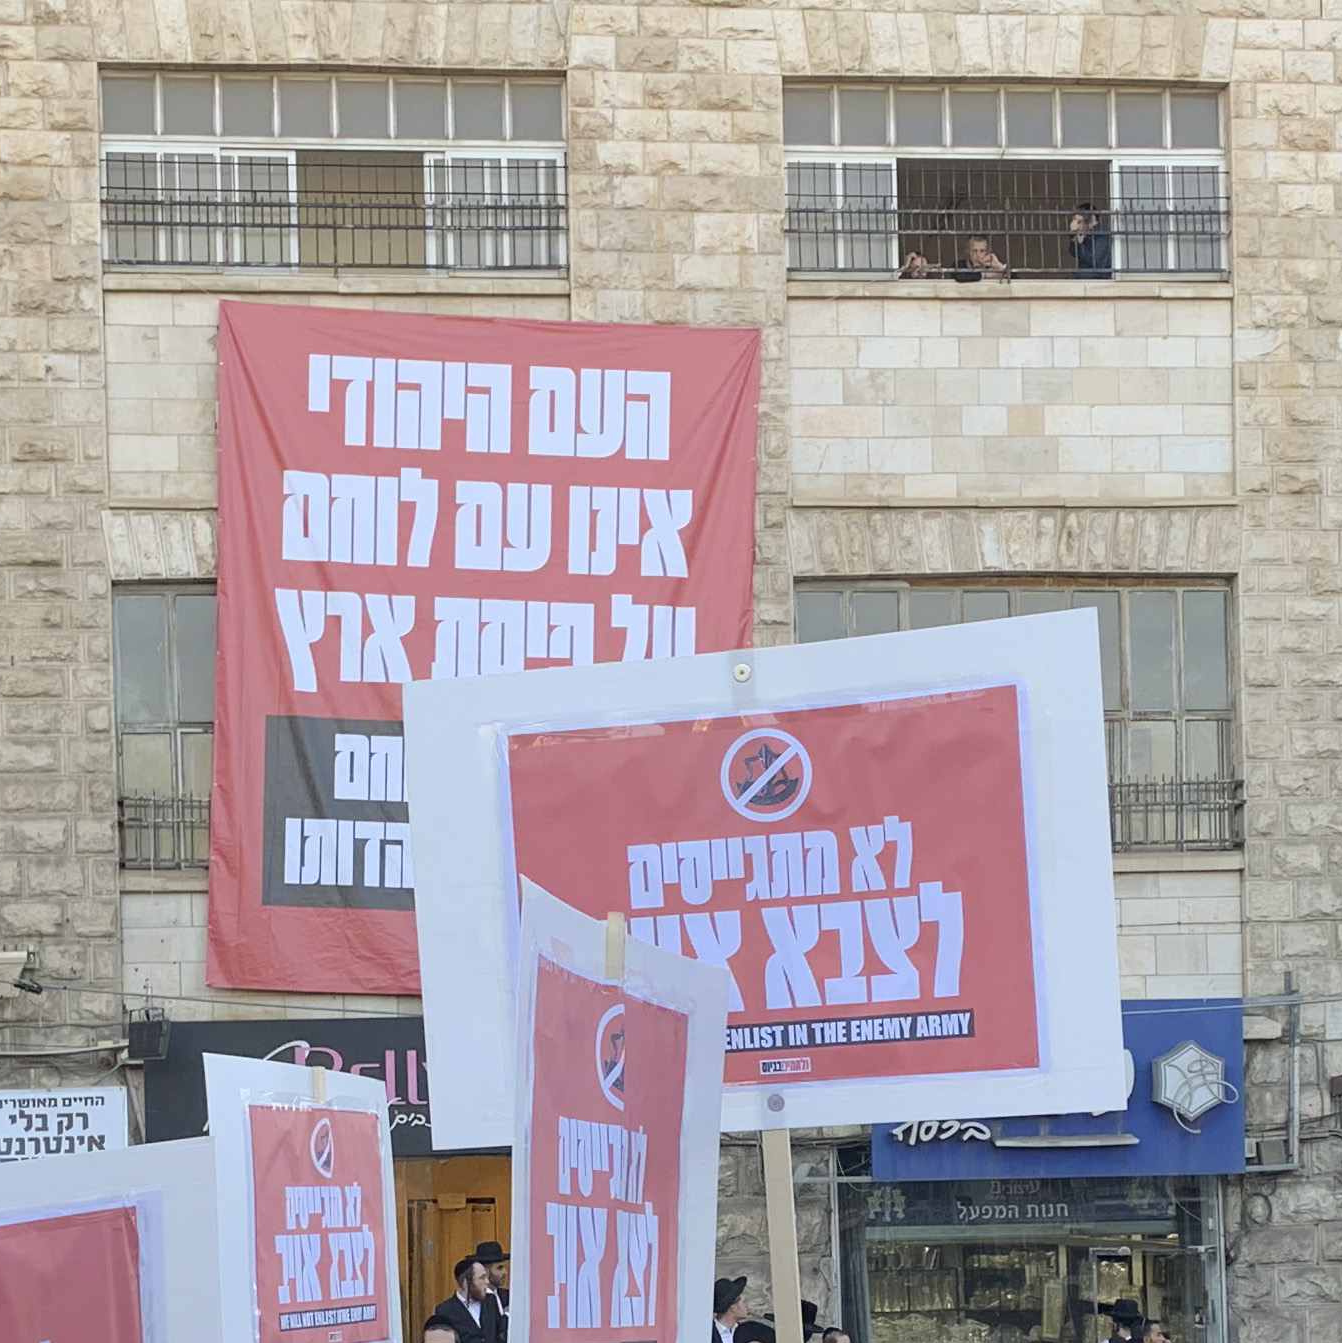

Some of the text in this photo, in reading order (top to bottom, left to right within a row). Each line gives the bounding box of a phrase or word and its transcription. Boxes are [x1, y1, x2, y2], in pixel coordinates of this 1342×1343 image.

[308, 353, 671, 461] העם היהודי
[282, 467, 693, 578] אינו עם לוחם
[274, 587, 416, 693] ארץ
[431, 596, 595, 680] פיסת
[334, 733, 409, 803] חם
[627, 815, 913, 910] לא מתגייסים
[761, 881, 964, 1010] לצבא
[789, 1023, 809, 1046] IN
[812, 1020, 847, 1044] THE
[851, 1015, 912, 1042] ENEMY
[916, 1012, 971, 1037] ARMY
[8, 1109, 89, 1135] רק בלי
[62, 1096, 105, 1107] החיים
[957, 1202, 1069, 1222] חנות המפעל
[275, 1224, 375, 1304] לצבא אויב
